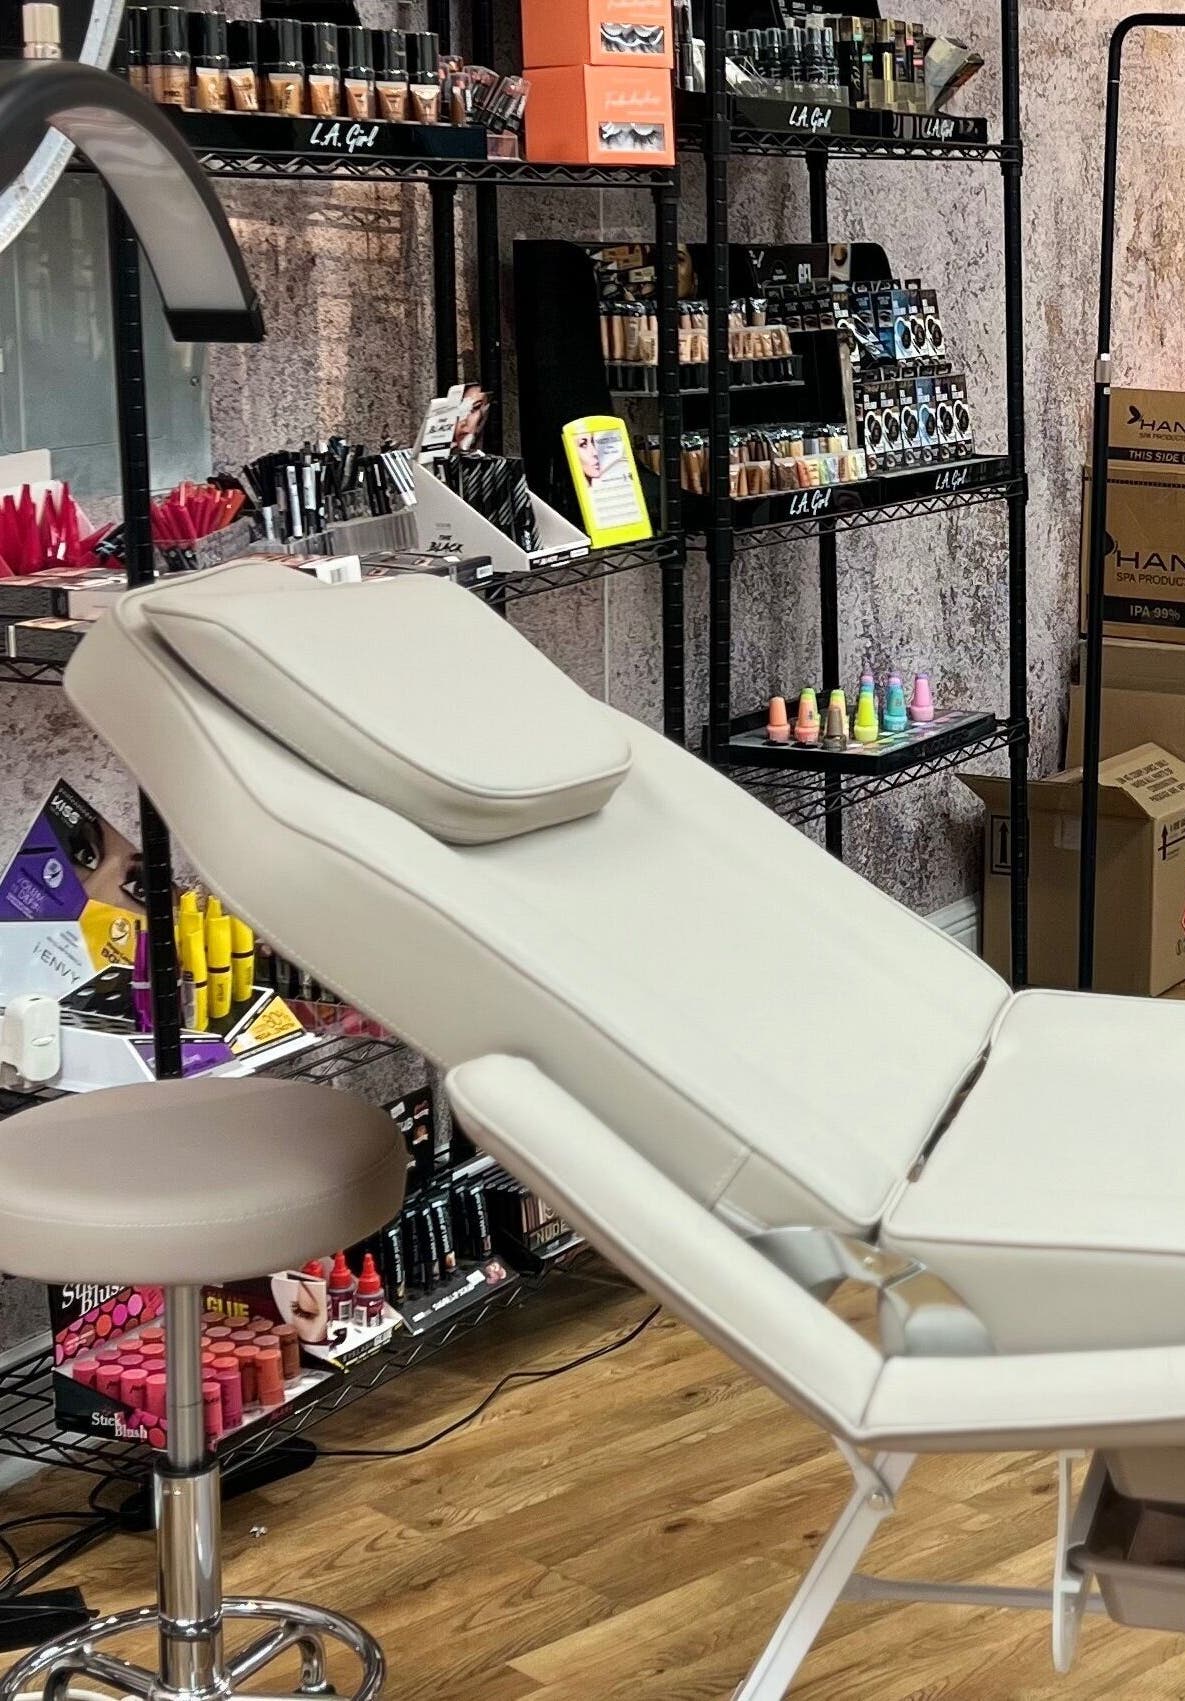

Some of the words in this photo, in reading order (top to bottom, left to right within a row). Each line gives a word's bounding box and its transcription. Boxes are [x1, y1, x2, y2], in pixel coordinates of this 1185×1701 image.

[310, 122, 342, 147] L.A.
[345, 123, 380, 153] Girl
[1128, 450, 1153, 461] THIS
[1155, 452, 1180, 463] SIDE
[426, 542, 464, 553] BLACK
[1116, 572, 1137, 584] SPA
[1129, 605, 1151, 617] IPA
[536, 1218, 571, 1244] NUDE
[79, 1283, 126, 1318] Blus
[206, 1296, 250, 1318] GLUE
[91, 1411, 121, 1426] Stick
[114, 1424, 148, 1439] Blush
